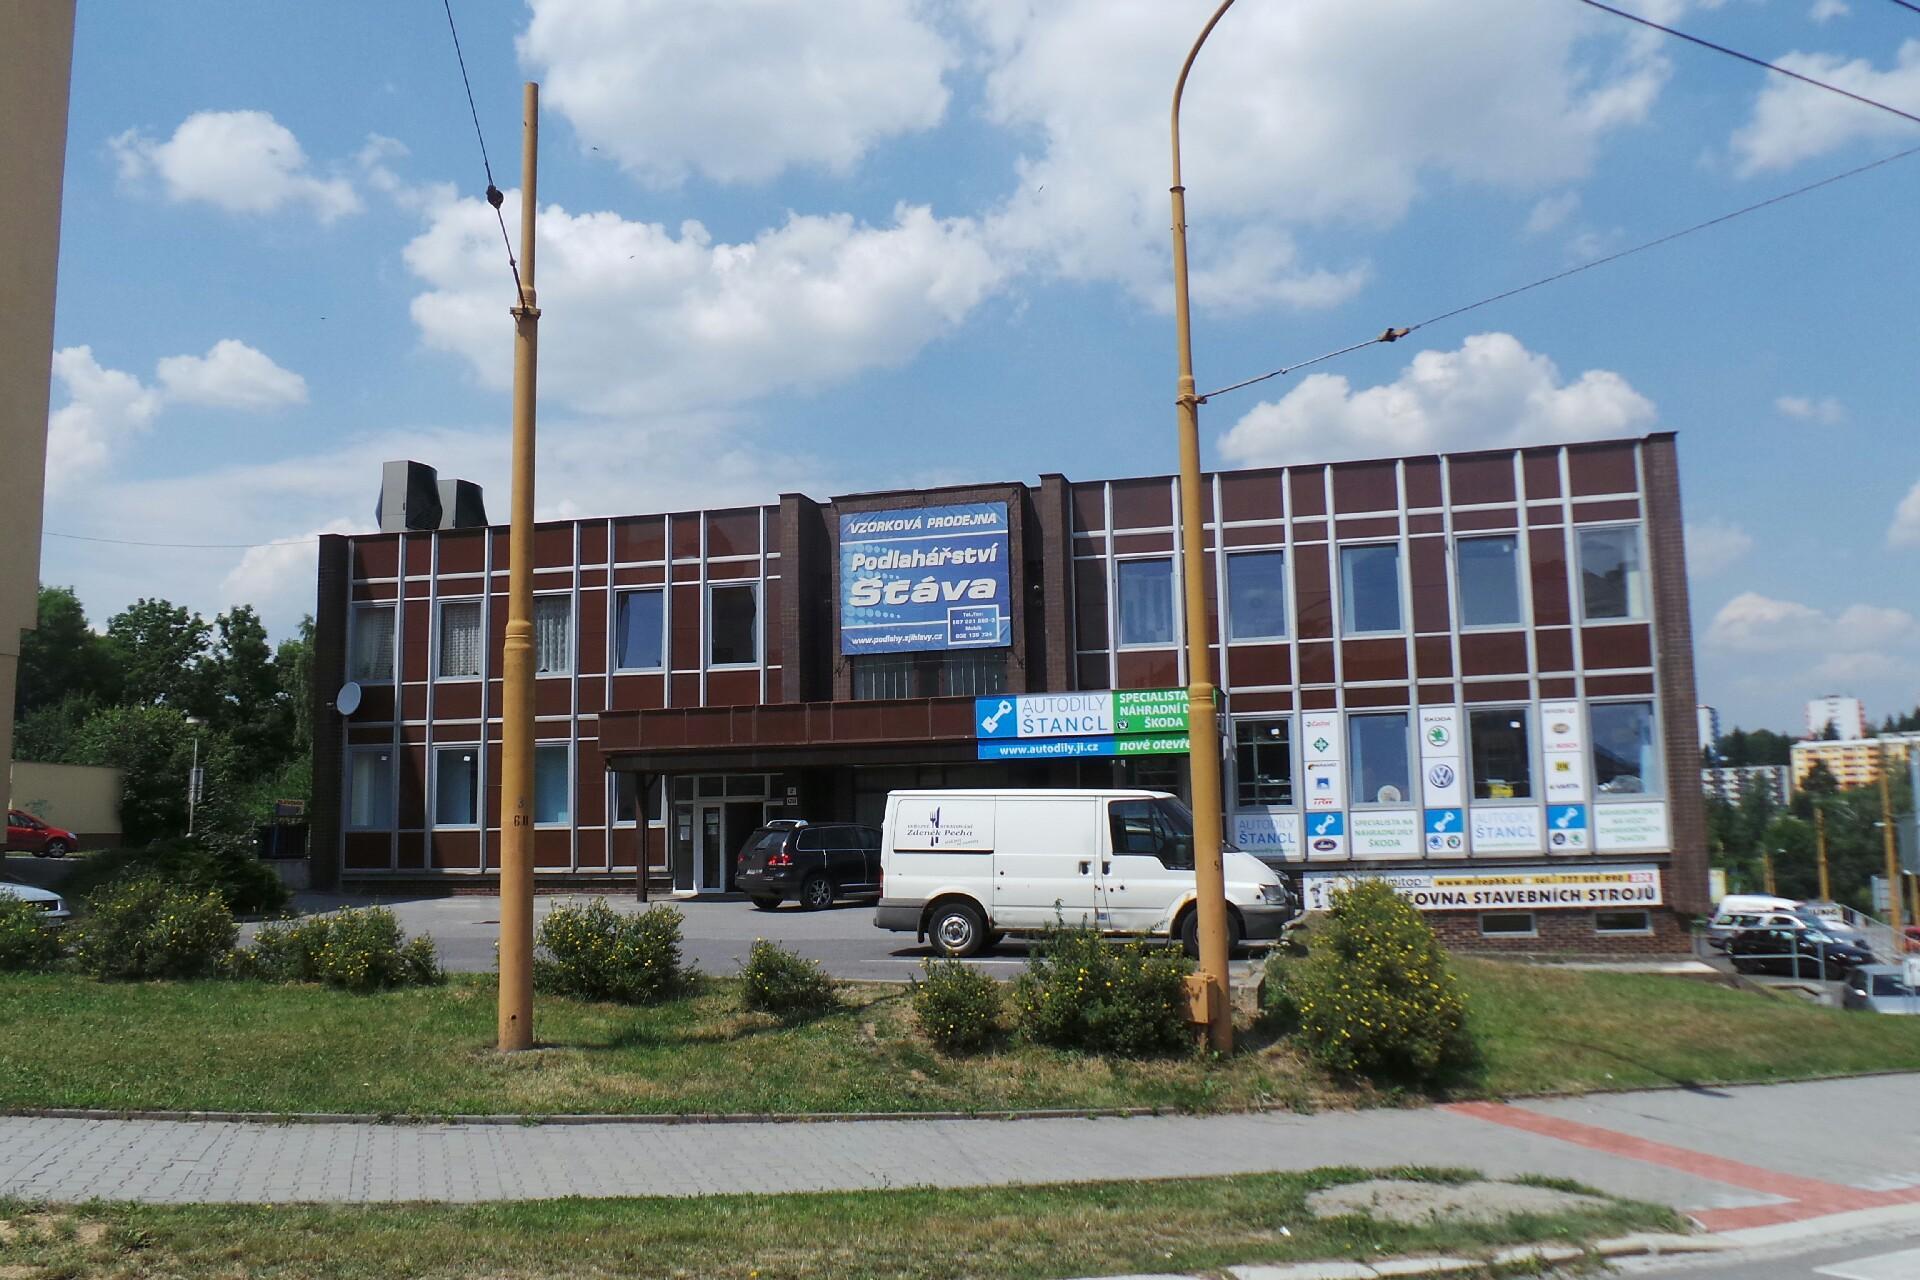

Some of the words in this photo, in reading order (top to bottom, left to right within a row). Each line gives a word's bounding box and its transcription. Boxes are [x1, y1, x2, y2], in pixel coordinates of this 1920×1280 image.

[850, 515, 922, 534] VZORKOVÁ
[927, 512, 997, 529] PRODEJNA
[851, 542, 999, 572] Podlahářství
[1119, 690, 1188, 703] SPECIALISTA
[1119, 702, 1181, 716] NÁHRADNÍ
[1023, 714, 1108, 734] ŠTANCL
[1144, 715, 1184, 728] ŠKODA
[1119, 738, 1150, 751] nové
[1152, 736, 1190, 750] otevře
[1239, 830, 1296, 844] ŠTANCL
[1476, 824, 1535, 838] ŠTANCL
[1473, 886, 1581, 904] STAVEBNÍCH
[1588, 885, 1655, 902] STROJŮ
